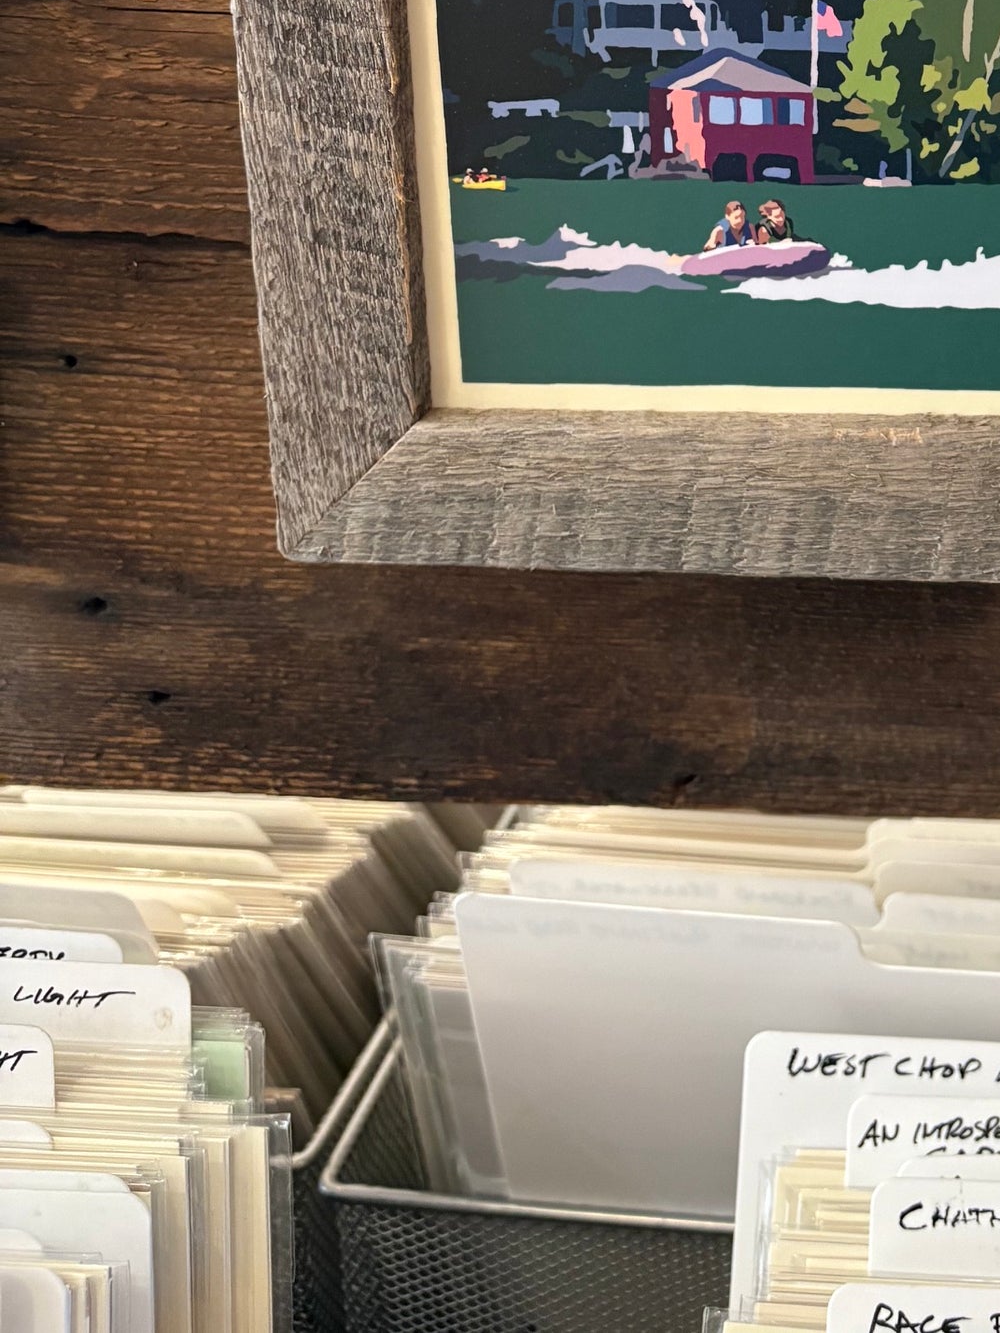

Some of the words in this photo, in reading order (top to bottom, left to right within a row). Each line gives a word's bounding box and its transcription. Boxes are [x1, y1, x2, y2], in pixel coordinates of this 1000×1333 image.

[12, 985, 137, 1009] LIGHT
[786, 1047, 891, 1079] WEST
[893, 1055, 983, 1081] CHOP
[857, 1118, 900, 1149] AN
[868, 1302, 972, 1333] RACE
